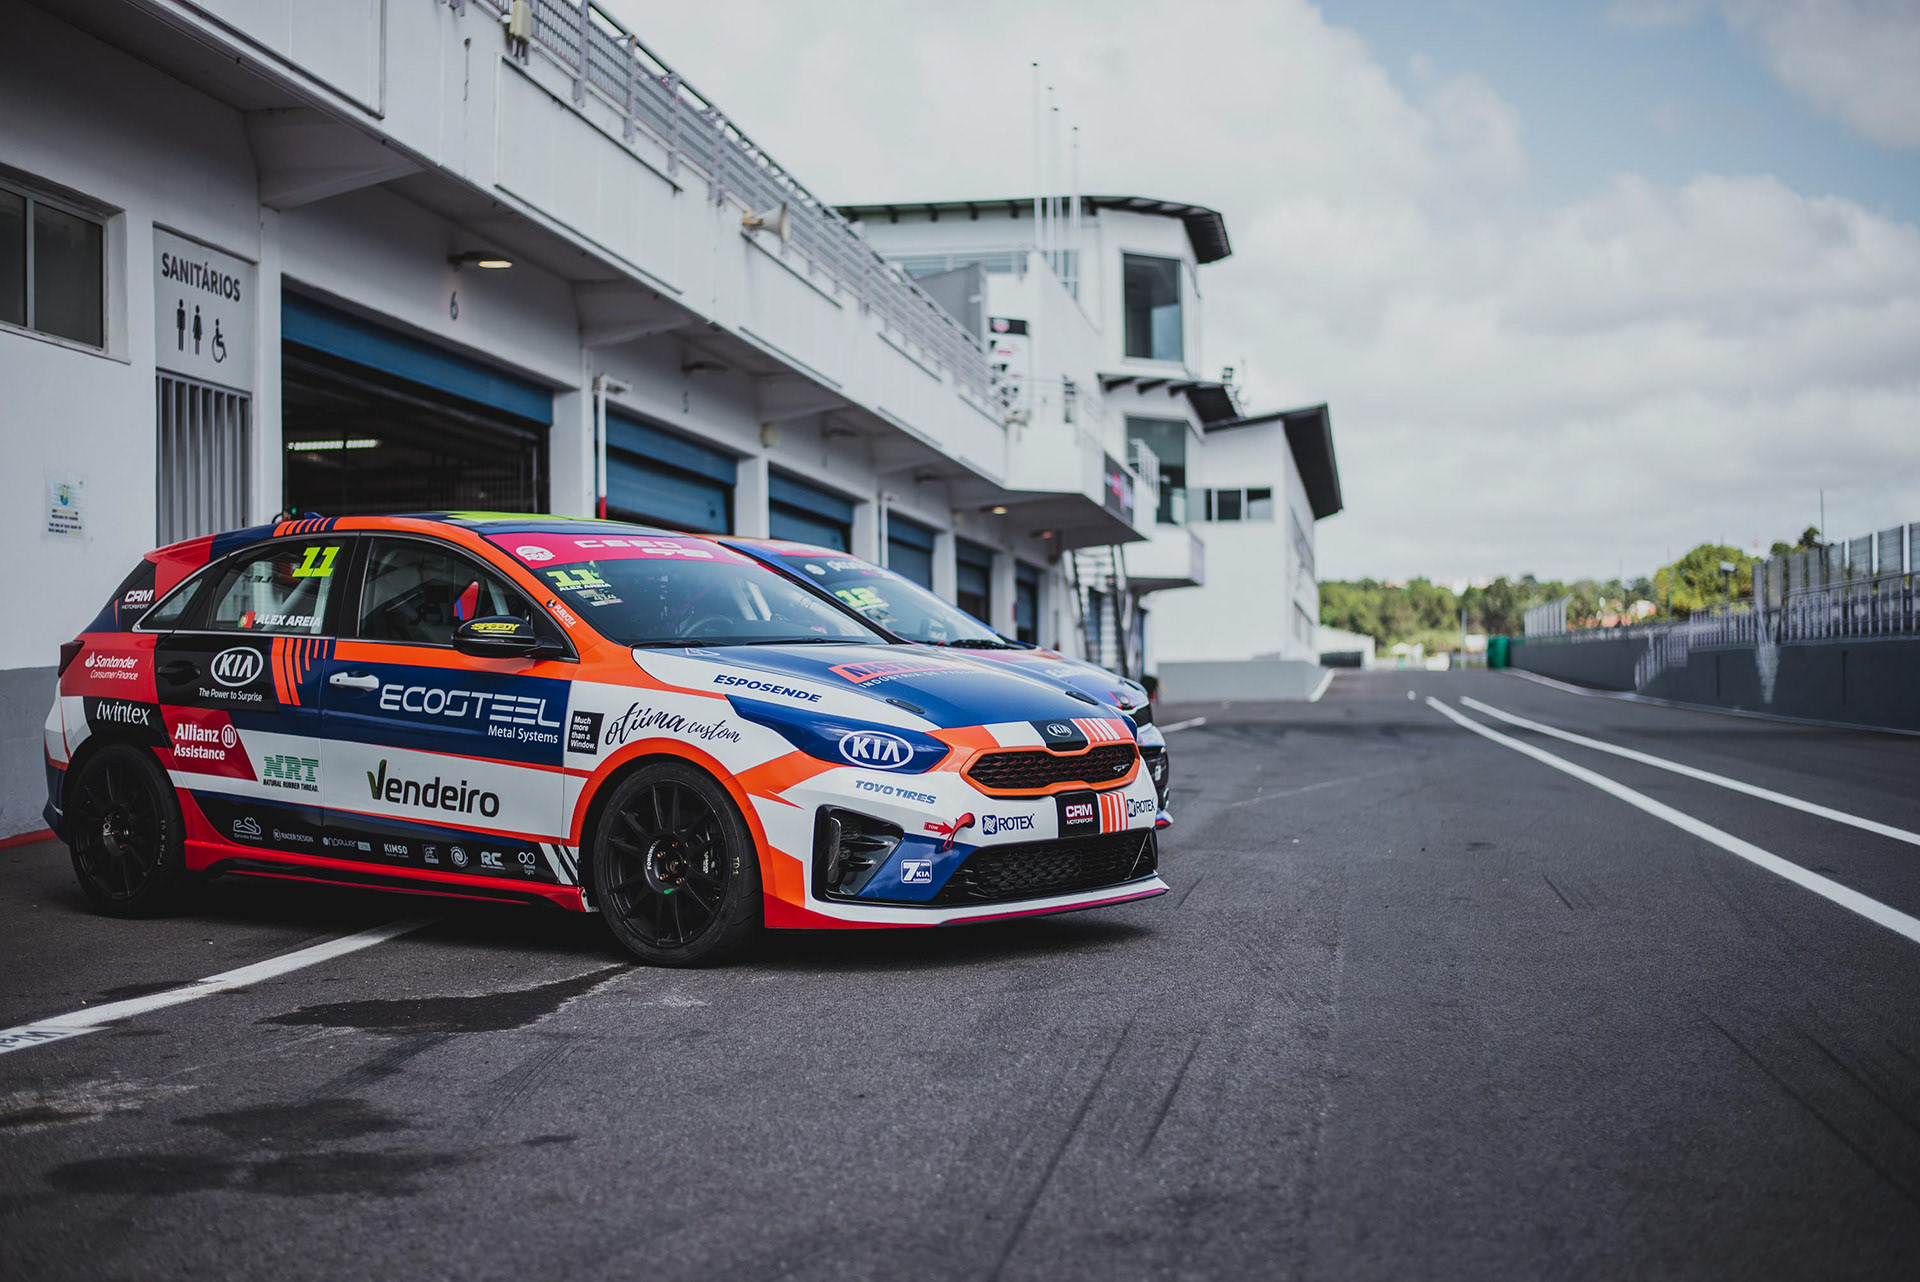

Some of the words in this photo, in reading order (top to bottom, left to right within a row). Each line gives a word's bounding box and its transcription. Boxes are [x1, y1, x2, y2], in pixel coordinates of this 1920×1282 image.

[162, 252, 241, 302] SANITÁRIOS
[450, 291, 459, 321] 6
[292, 546, 340, 578] 11
[546, 569, 606, 588] 11
[124, 590, 154, 603] CRM
[834, 588, 884, 608] 12
[256, 614, 287, 626] ALEX
[286, 616, 322, 628] AREIA
[470, 622, 520, 631] SPEEDY
[95, 654, 138, 669] Santander
[218, 653, 254, 678] KIA
[90, 669, 116, 679] Consumer
[116, 671, 138, 681] Finance
[199, 688, 210, 697] The
[210, 689, 229, 700] Power
[230, 690, 237, 699] to
[238, 692, 262, 702] Surprise
[712, 674, 822, 702] ESPOSENDE
[96, 700, 150, 726] twintex
[380, 684, 560, 728] ECOSTEEL
[574, 716, 592, 725] Much
[174, 722, 220, 744] Allianz
[488, 724, 516, 739] Metal
[518, 726, 558, 744] Systems
[572, 732, 586, 740] than
[688, 720, 742, 744] custom
[174, 744, 226, 760] Assistance
[852, 736, 900, 762] KIA
[263, 754, 320, 782] NRT
[262, 778, 282, 790] NATURAL
[282, 780, 300, 791] RUBBER
[366, 758, 500, 818] Vendeiro
[855, 780, 894, 796] TOYO
[895, 788, 937, 804] TIRES
[1066, 803, 1093, 818] CRM
[1136, 799, 1156, 814] ROTEX
[998, 814, 1034, 832] ROTEX
[1066, 817, 1094, 825] MOTORSPORT
[480, 852, 504, 866] RC
[904, 862, 920, 881] 7
